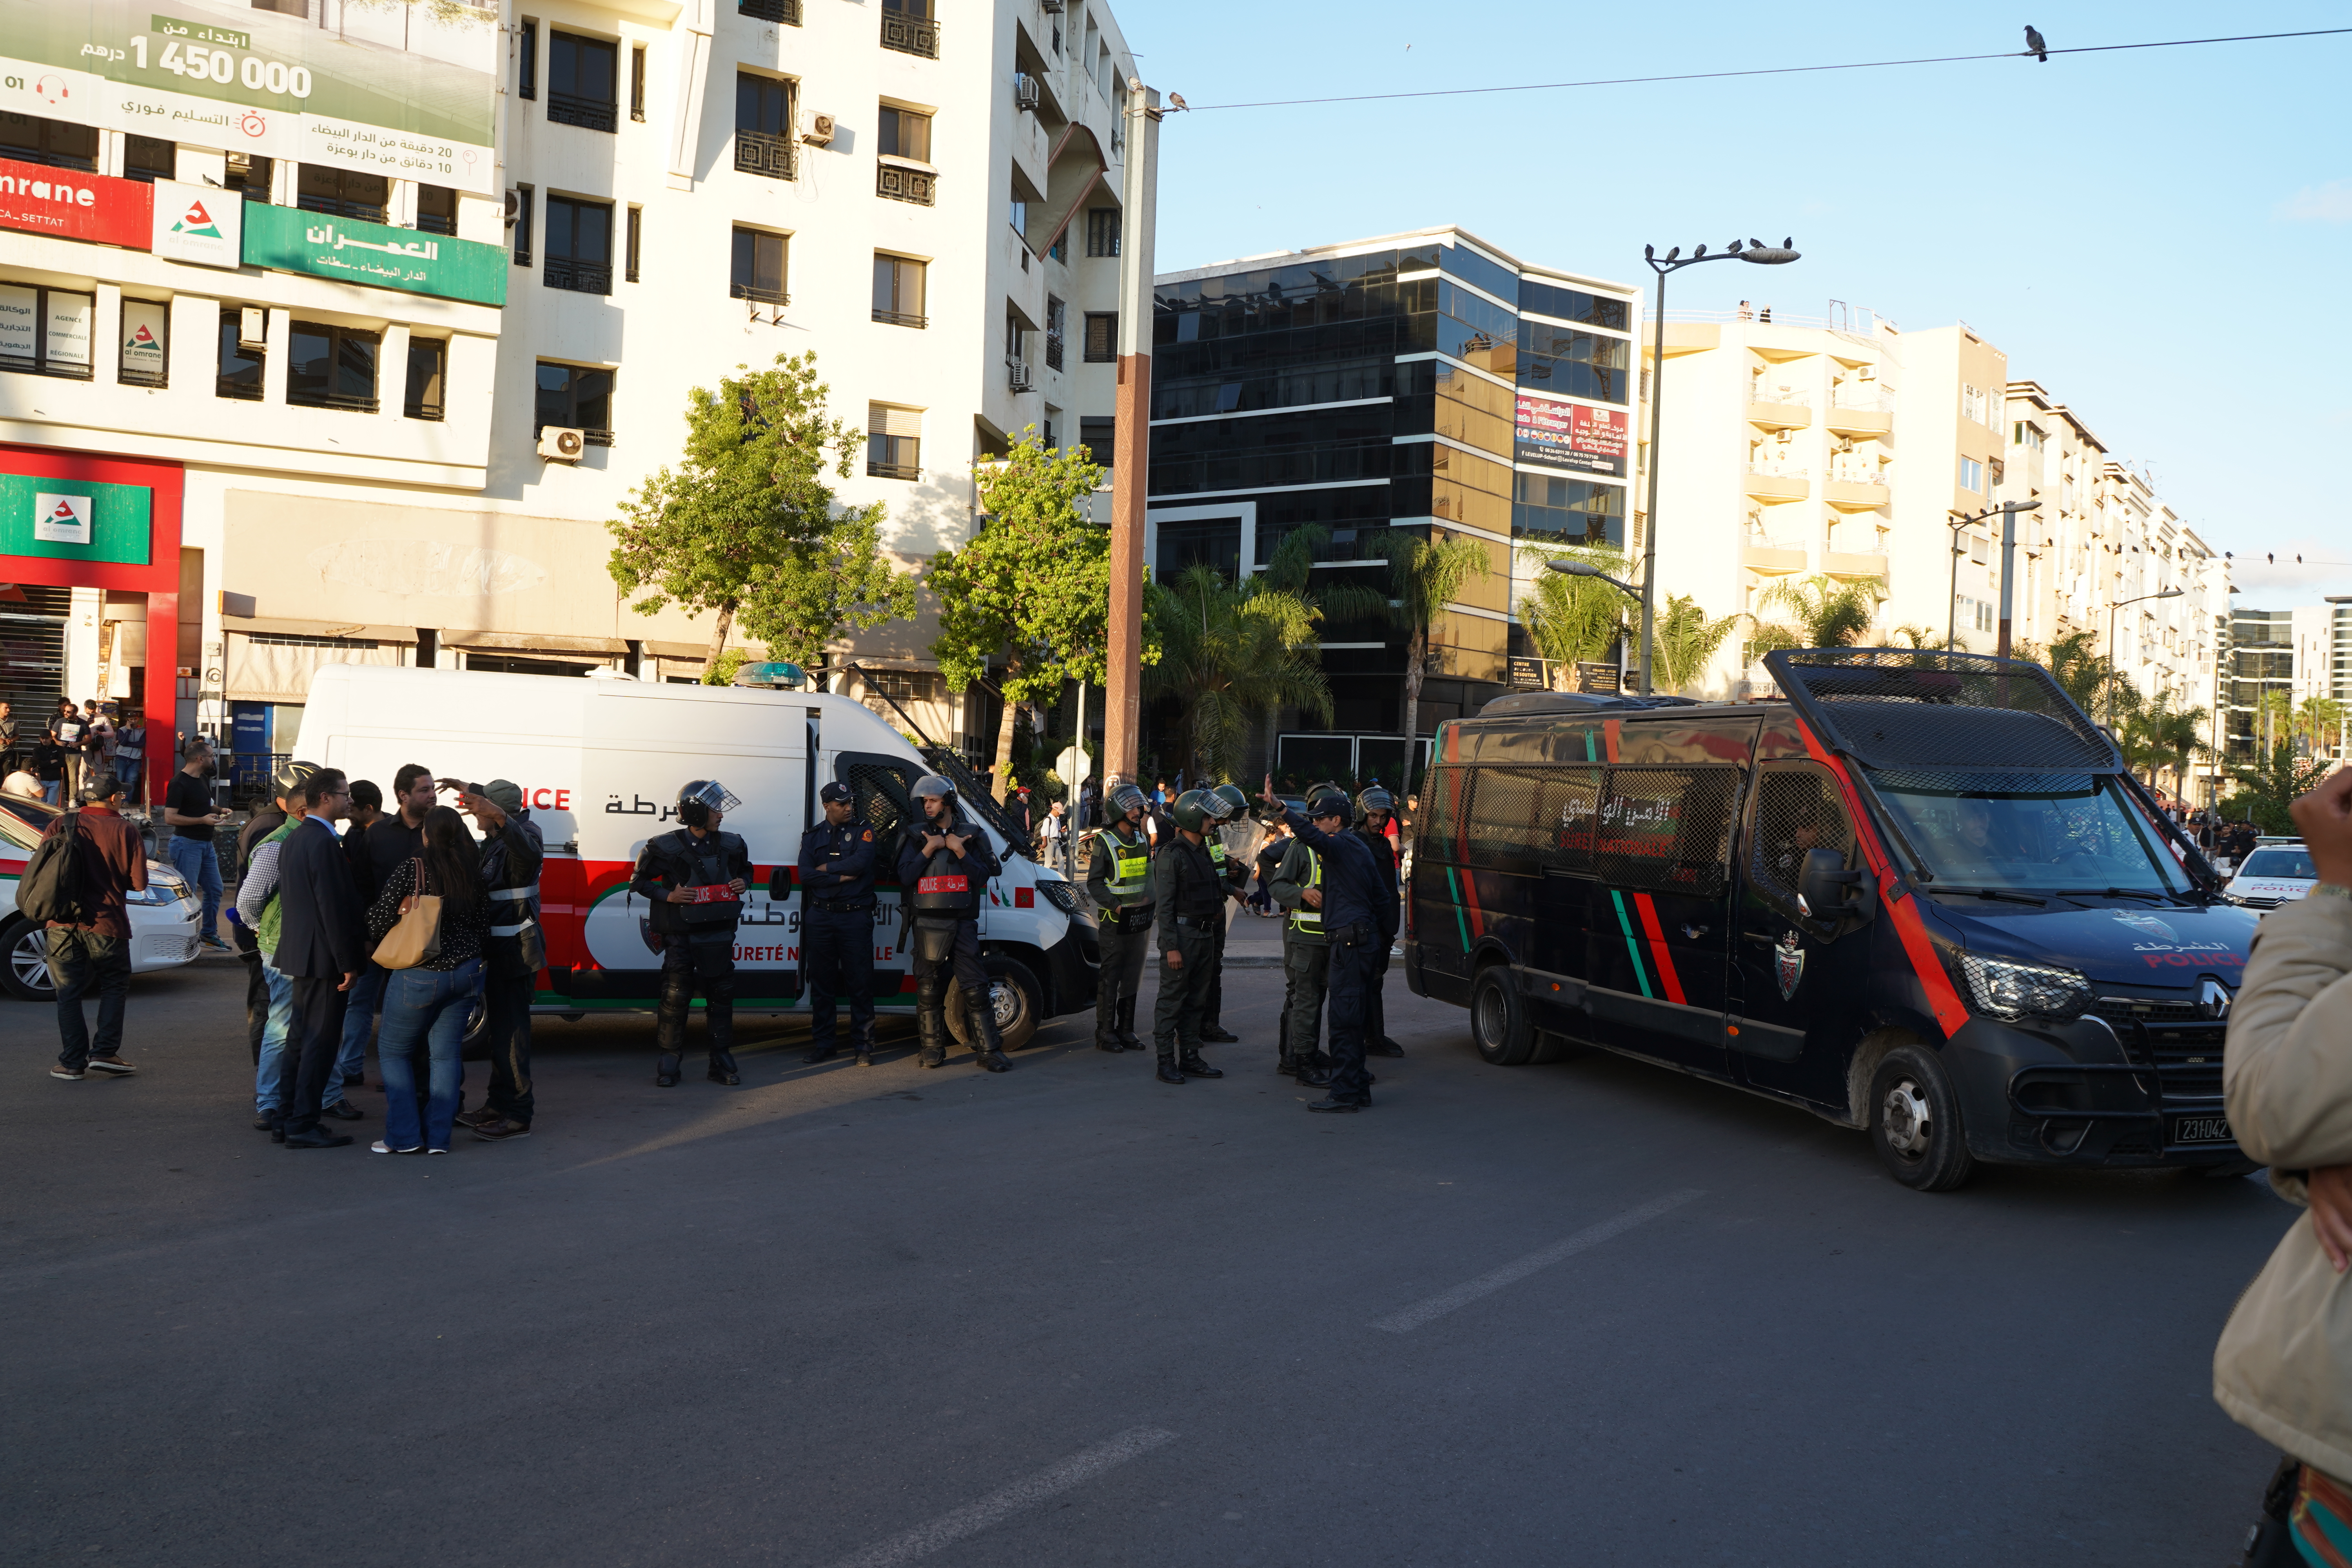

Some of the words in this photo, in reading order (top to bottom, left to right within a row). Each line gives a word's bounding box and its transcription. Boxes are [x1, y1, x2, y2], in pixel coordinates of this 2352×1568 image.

[163, 21, 188, 35] من
[198, 29, 246, 48] ابتداء
[80, 43, 125, 62] درهم
[131, 35, 147, 69] 1
[160, 41, 234, 84] 450
[241, 56, 312, 98] 000
[122, 101, 165, 115] فوري
[172, 109, 229, 126] التسليم
[312, 123, 349, 139] البيضاء
[353, 131, 376, 143] الدار
[380, 137, 396, 147] من
[400, 139, 434, 154] دقيقة
[327, 143, 358, 157] بوعزة
[361, 149, 376, 160] دار
[437, 146, 452, 158] 20
[380, 154, 396, 163] من
[400, 157, 433, 170] دقائق
[438, 162, 452, 174] 10
[307, 224, 438, 260] العمران
[316, 256, 350, 269] سطات
[360, 262, 400, 278] البيضاء
[402, 270, 426, 281] الدار
[0, 305, 30, 315] الوكالة
[55, 315, 82, 323] AGENCE
[0, 323, 31, 332] التجارية
[48, 331, 87, 341] COMMERCIALE
[0, 340, 30, 350] الجهوية
[50, 349, 84, 359] RÉGIONALE
[1531, 404, 1544, 413] في
[1544, 404, 1571, 417] الدراسة
[1514, 412, 1530, 423] tude
[1532, 416, 1537, 424] à
[1537, 416, 1568, 429] l'étranger
[1606, 431, 1628, 441] الألماية
[920, 878, 937, 892] POLICE
[947, 877, 965, 890] شرطة
[1129, 913, 1147, 927] FORCES
[732, 943, 783, 961] ÛRETÉ
[2132, 941, 2230, 952] الشرطة
[2142, 953, 2247, 968] POLICE
